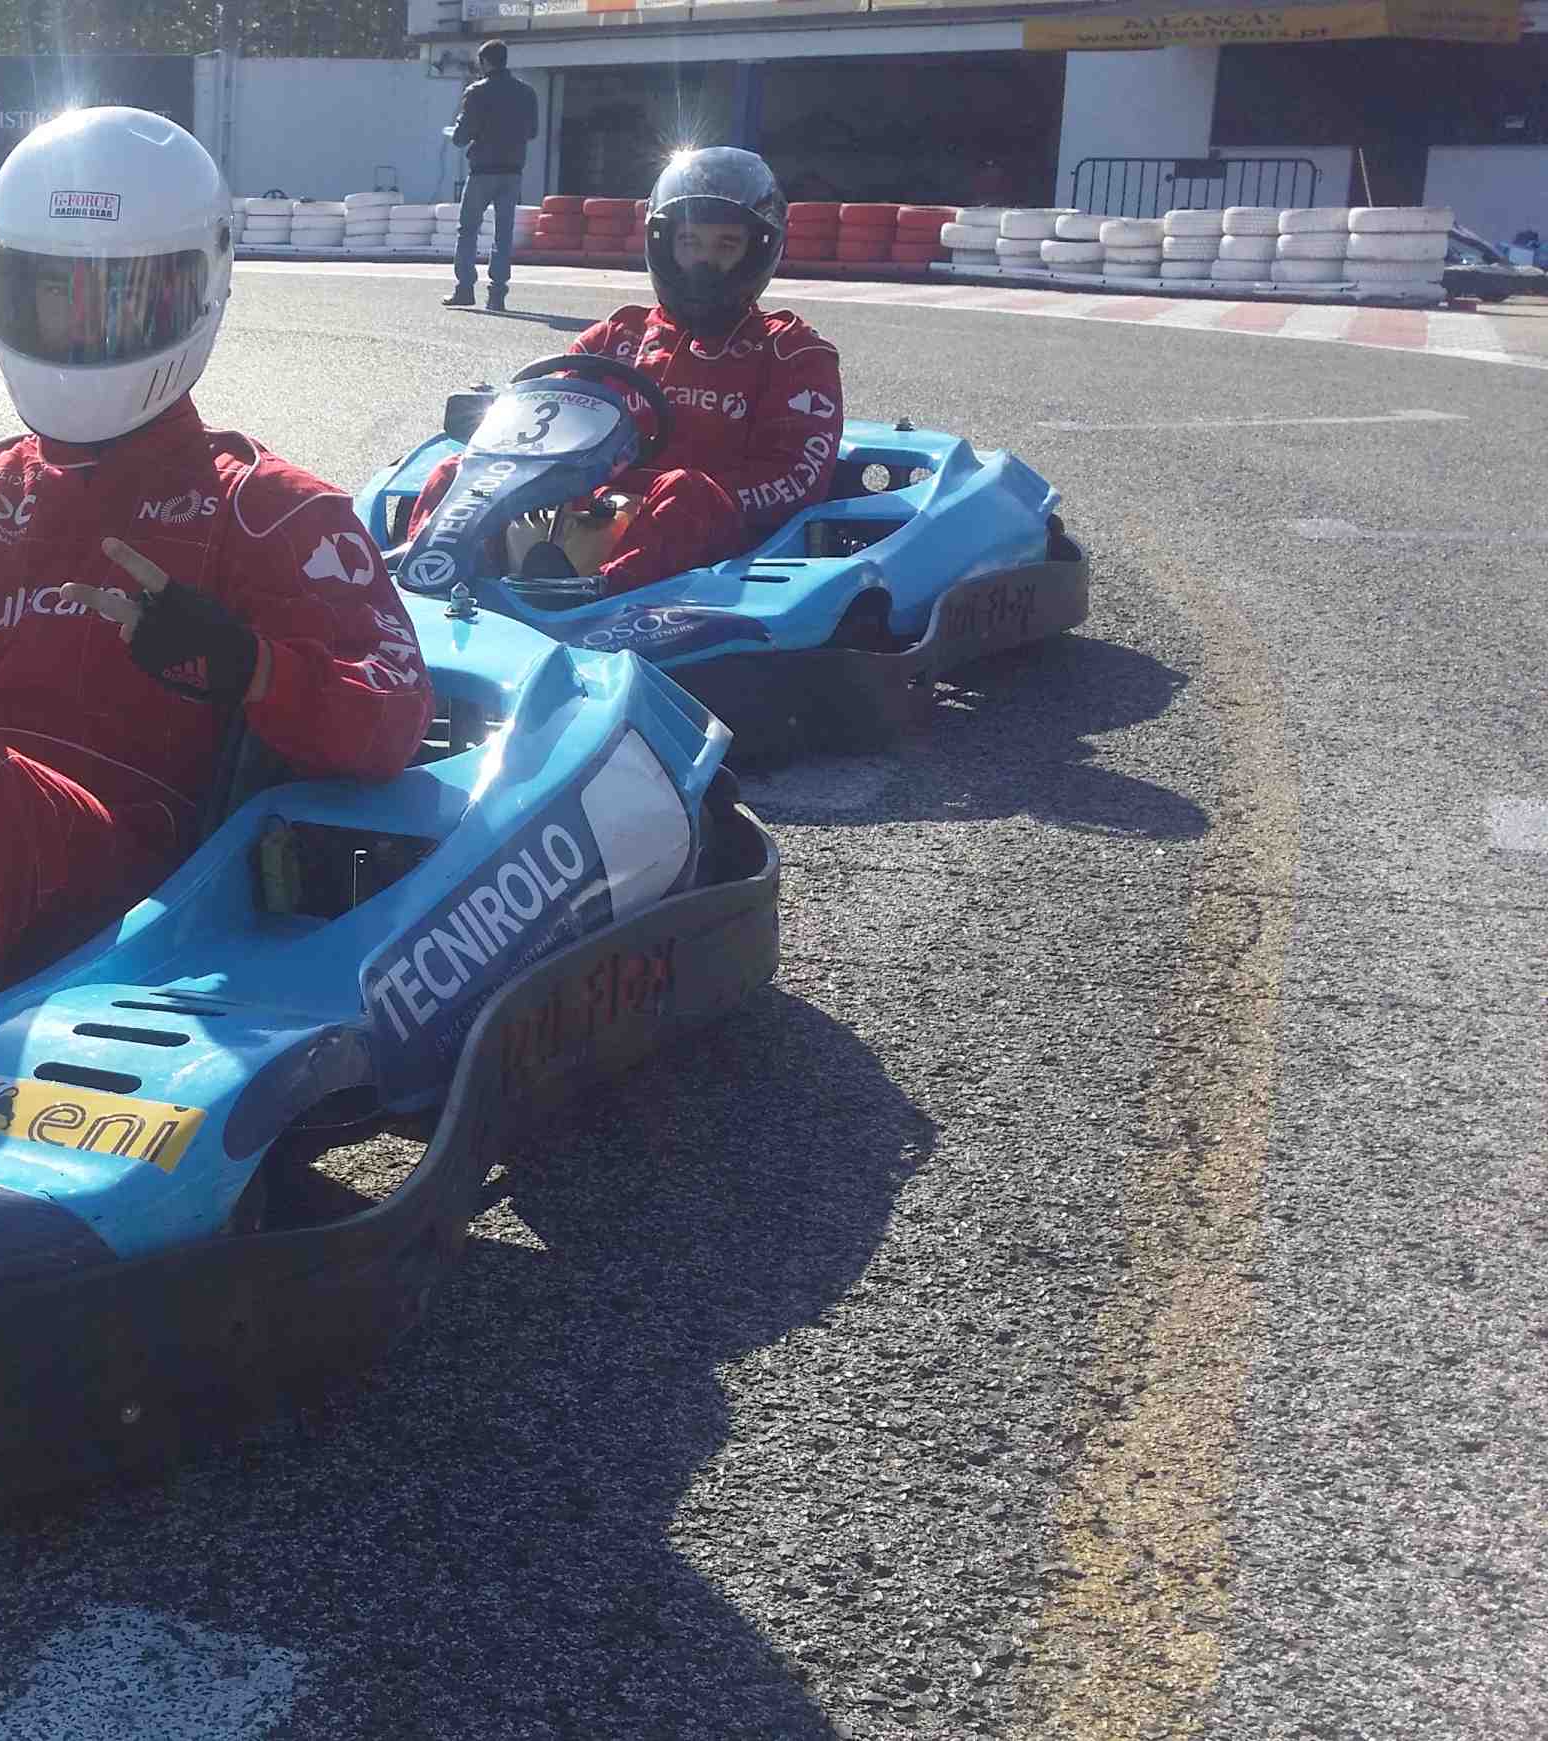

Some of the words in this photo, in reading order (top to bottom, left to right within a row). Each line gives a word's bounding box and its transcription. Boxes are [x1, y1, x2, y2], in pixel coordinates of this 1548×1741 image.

[515, 400, 561, 446] 3
[372, 823, 585, 1042] TECNIROLO
[27, 1102, 190, 1162] eni
